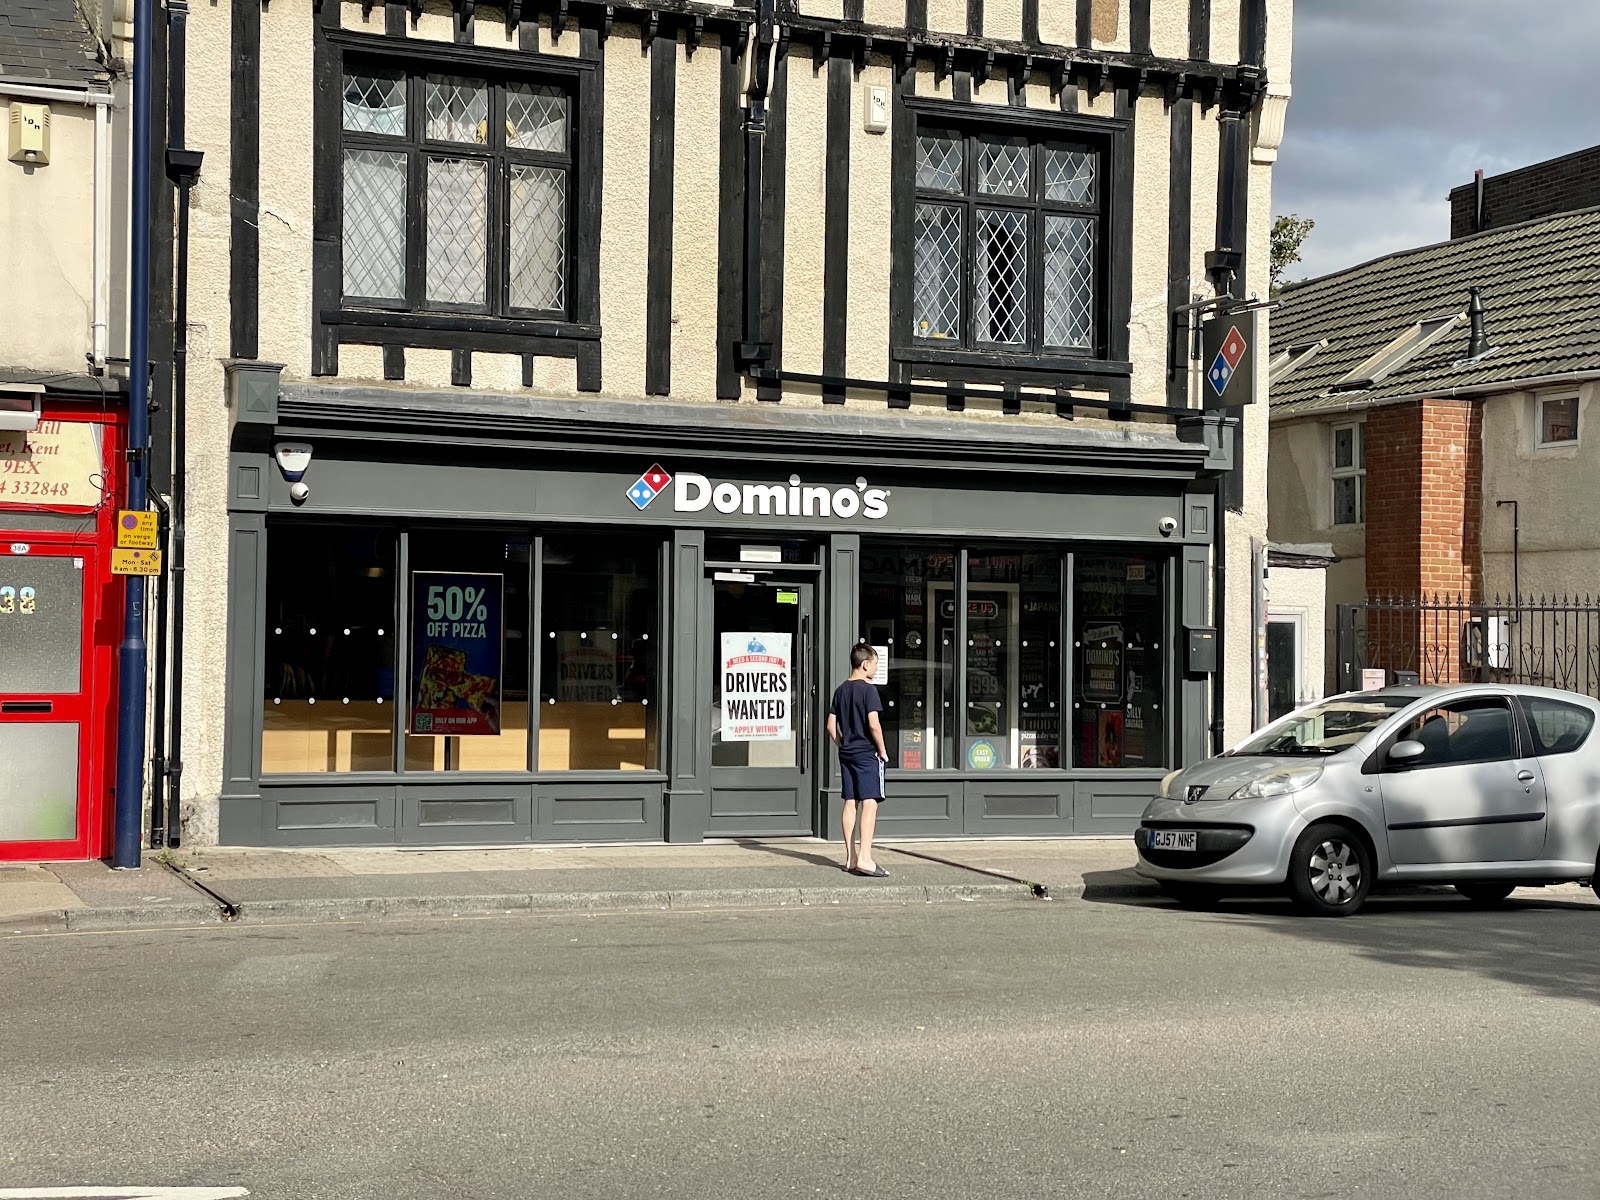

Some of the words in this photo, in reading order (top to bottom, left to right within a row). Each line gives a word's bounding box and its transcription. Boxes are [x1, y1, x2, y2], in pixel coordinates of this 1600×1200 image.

[20, 441, 60, 455] Kent
[3, 460, 42, 475] 9EX
[11, 481, 69, 496] 332848
[674, 471, 889, 519] Domino's
[0, 586, 35, 615] 38
[427, 586, 487, 621] 50%
[427, 622, 449, 637] OFF
[452, 623, 486, 638] PIZZA
[726, 672, 787, 692] DRIVERS
[727, 700, 785, 720] WANTED
[734, 726, 754, 734] APPLY
[1155, 832, 1176, 847] GJ57
[1177, 833, 1195, 848] NNF
